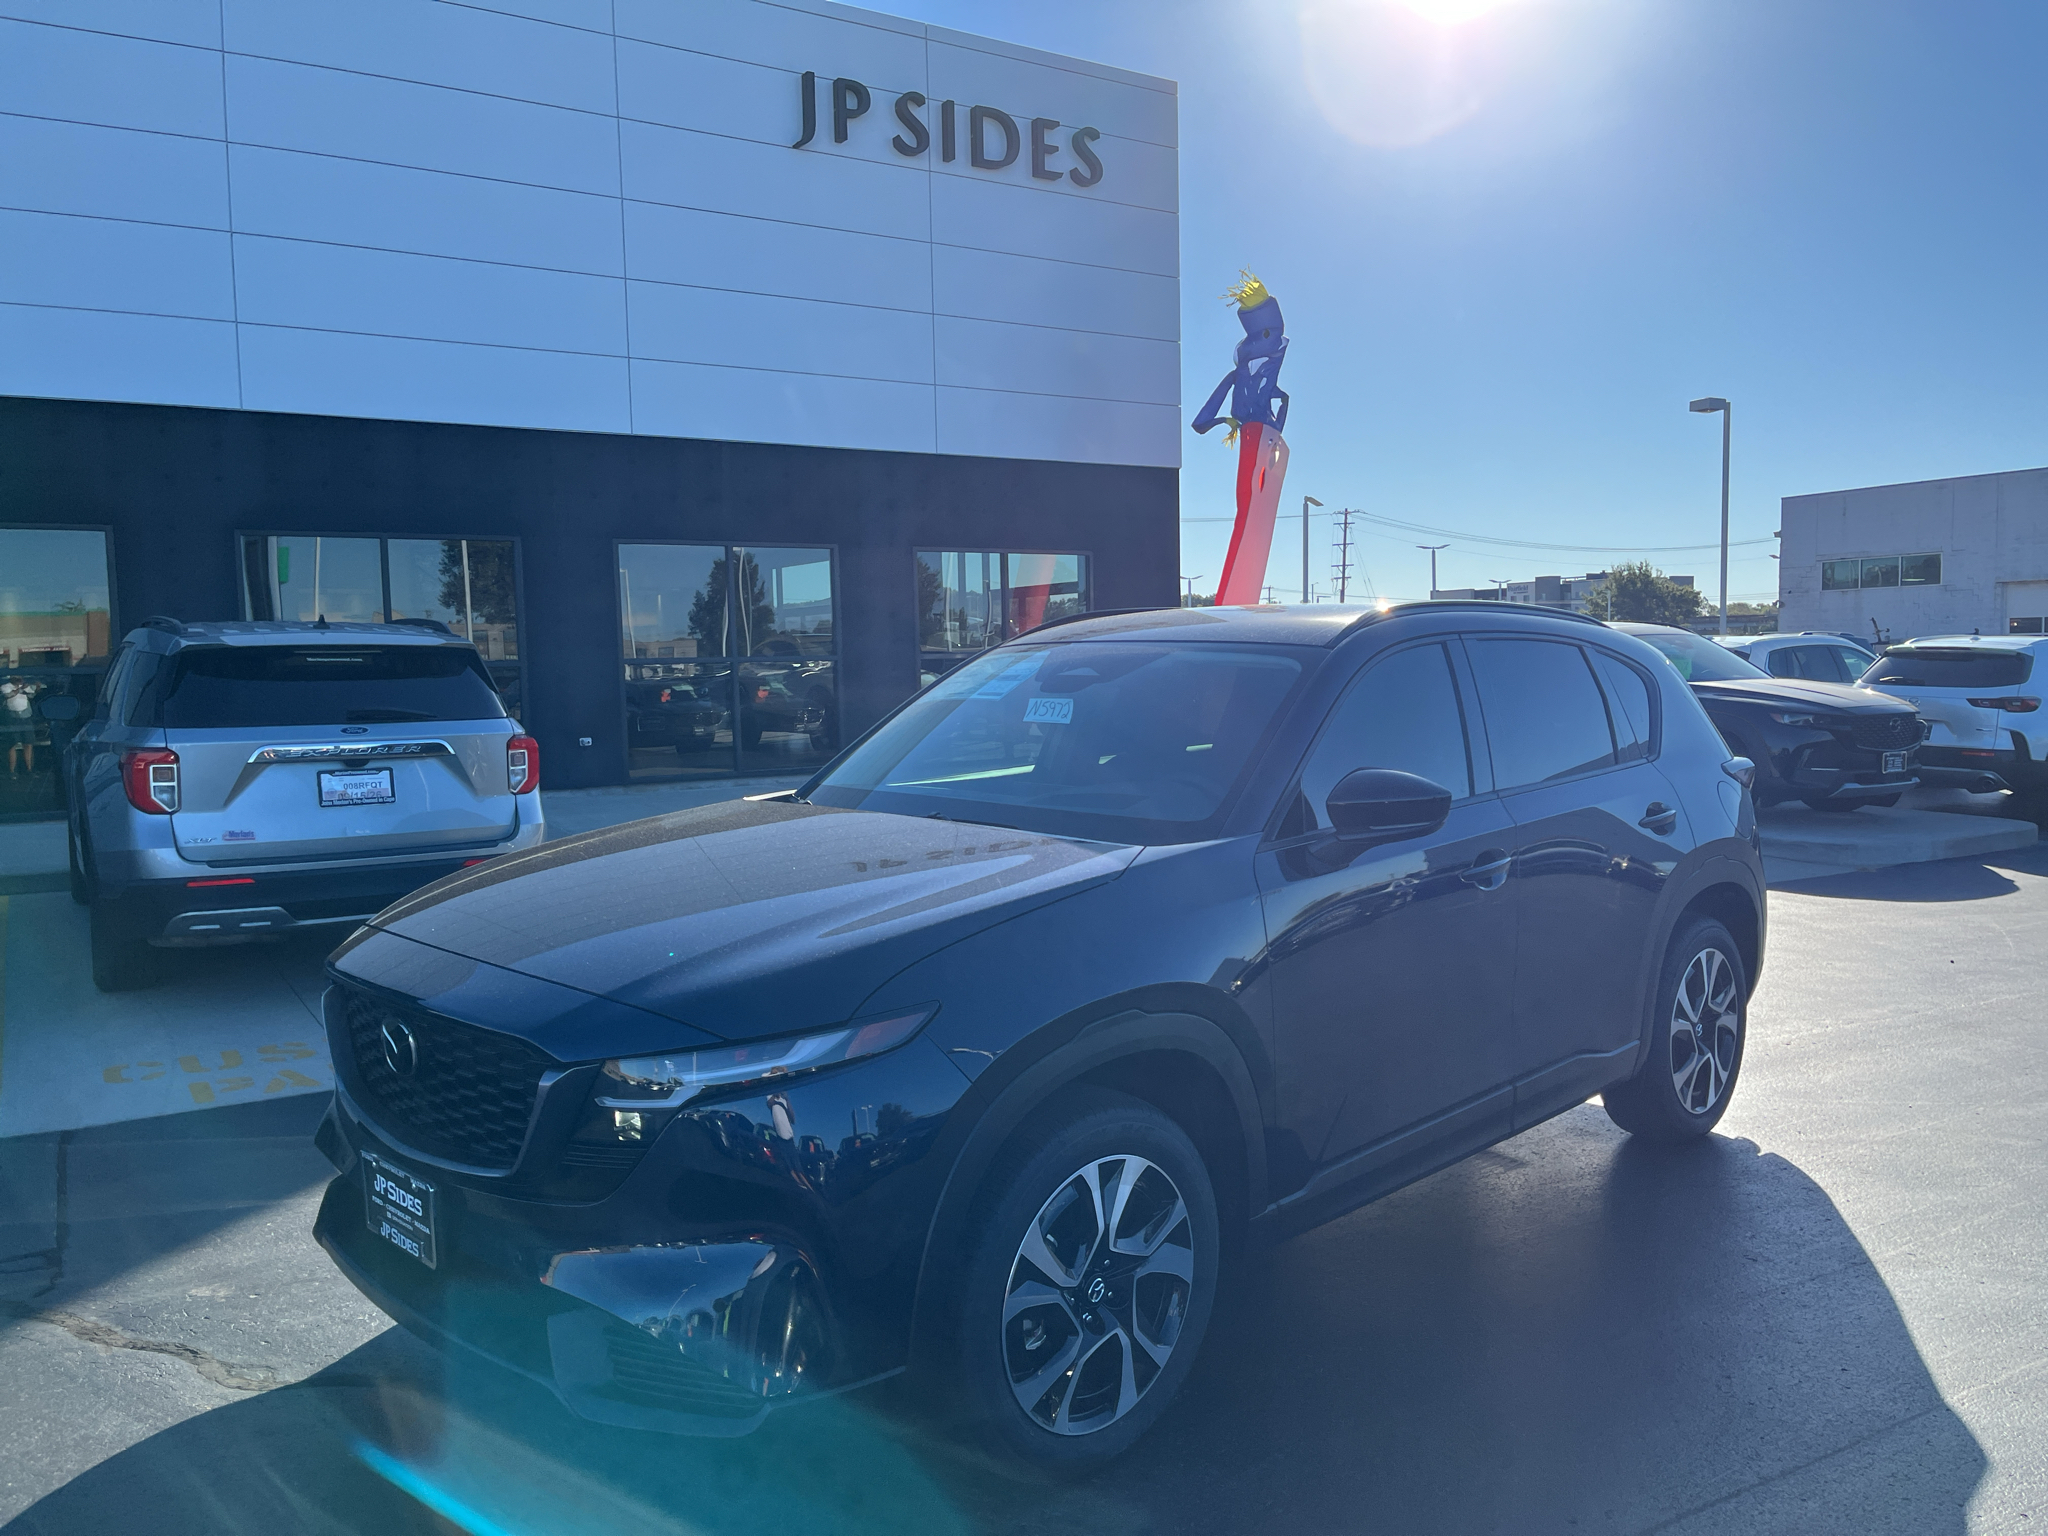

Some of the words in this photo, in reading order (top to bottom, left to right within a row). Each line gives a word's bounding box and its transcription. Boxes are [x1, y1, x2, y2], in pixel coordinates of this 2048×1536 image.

[792, 71, 871, 149] JP
[892, 91, 1104, 187] SIDES
[1026, 700, 1071, 719] N5972
[285, 745, 422, 758] EXPLORER
[103, 1042, 317, 1083] CUS
[374, 1174, 387, 1195] JP
[387, 1181, 423, 1217] SIDES
[381, 1222, 391, 1239] JP
[391, 1228, 419, 1258] SIDES
